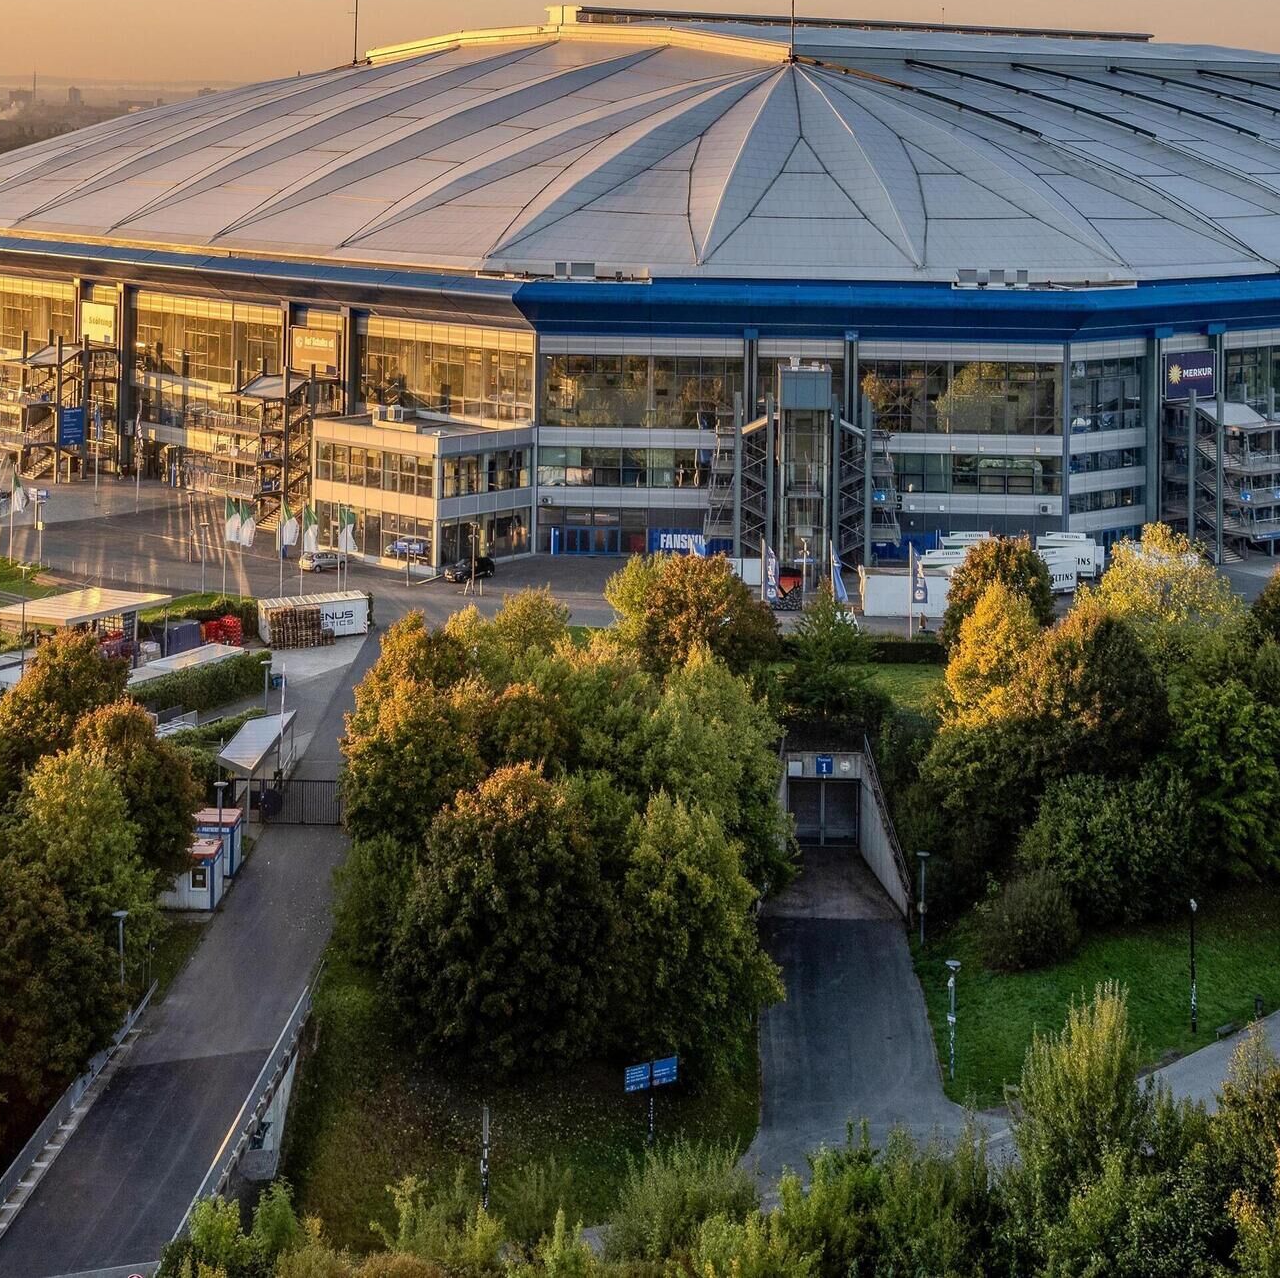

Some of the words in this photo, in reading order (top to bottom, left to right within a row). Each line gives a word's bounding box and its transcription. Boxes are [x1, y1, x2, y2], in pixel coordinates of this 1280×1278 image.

[1182, 367, 1213, 378] MERKUR
[660, 533, 705, 549] FANSHO
[821, 762, 827, 773] 1
